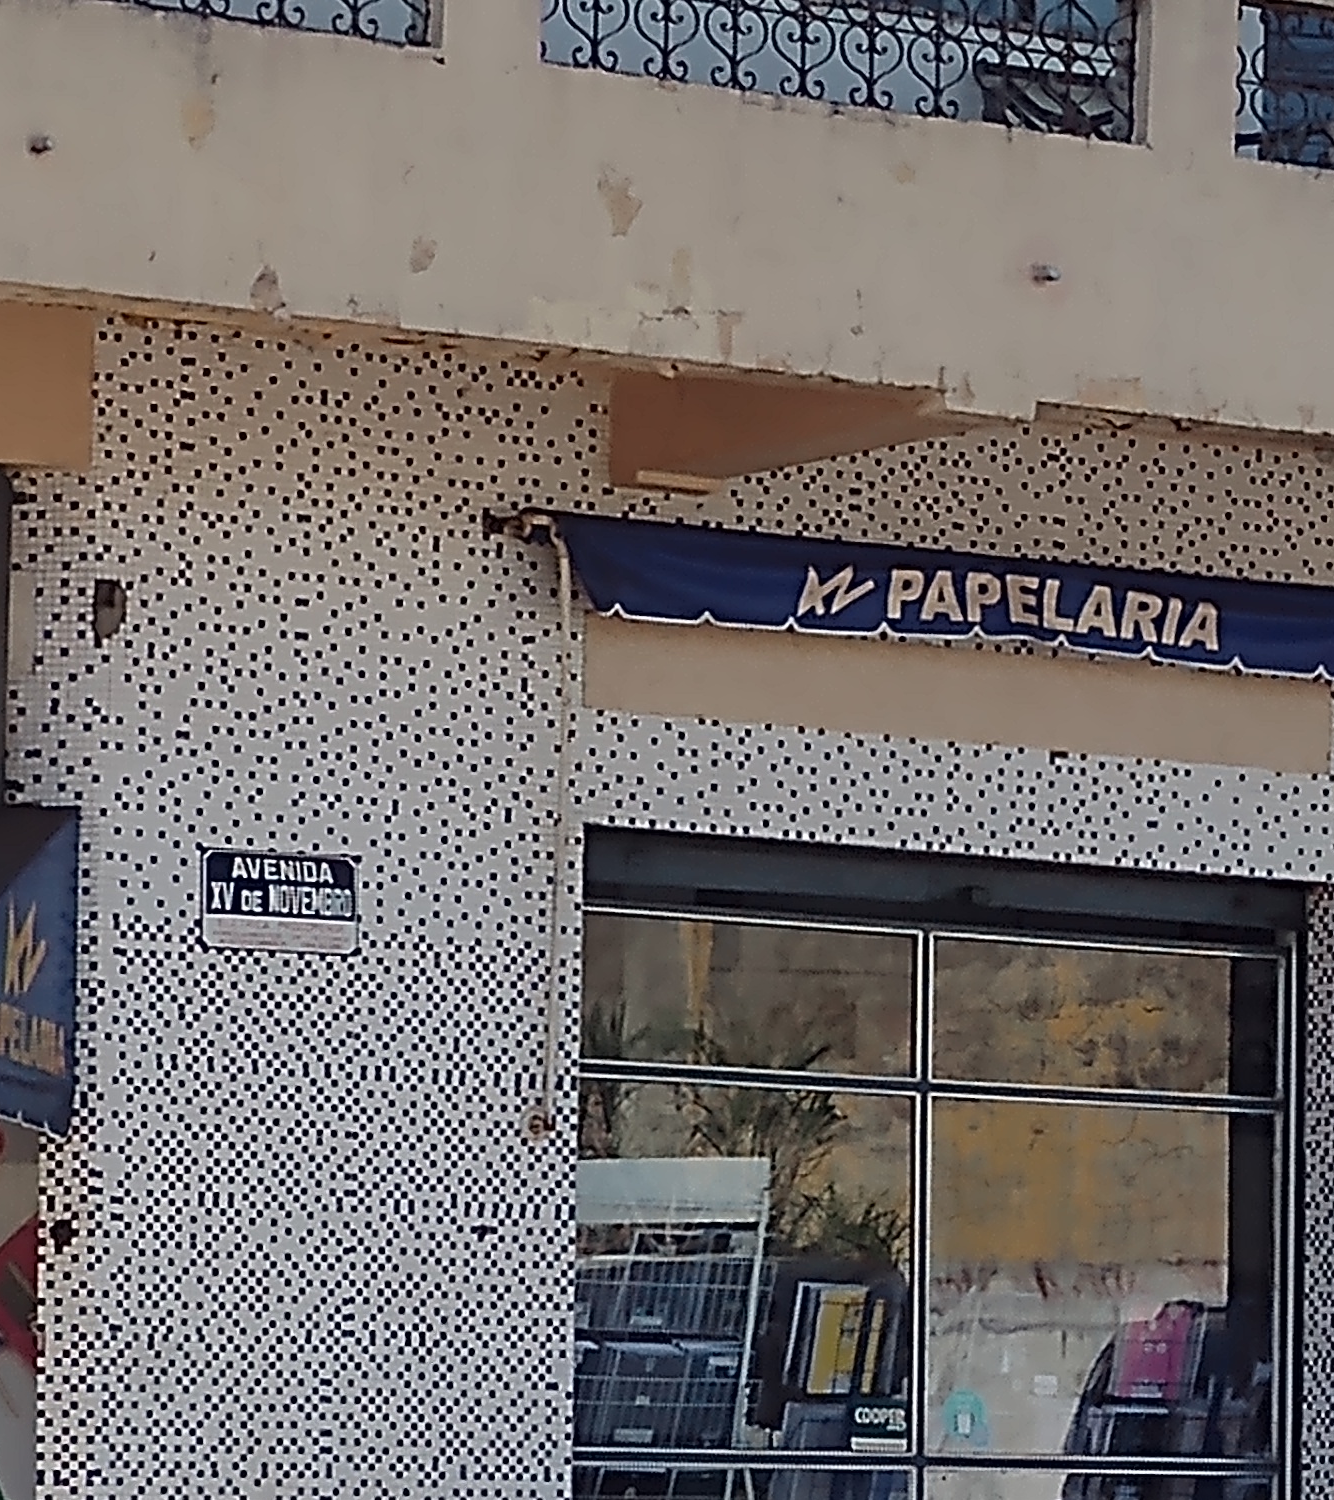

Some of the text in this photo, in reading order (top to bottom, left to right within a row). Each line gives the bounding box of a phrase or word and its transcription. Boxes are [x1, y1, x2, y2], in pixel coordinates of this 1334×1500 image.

[885, 567, 1221, 652] PAPELARIA
[231, 856, 335, 884] AVENIDA
[210, 881, 235, 912] XV
